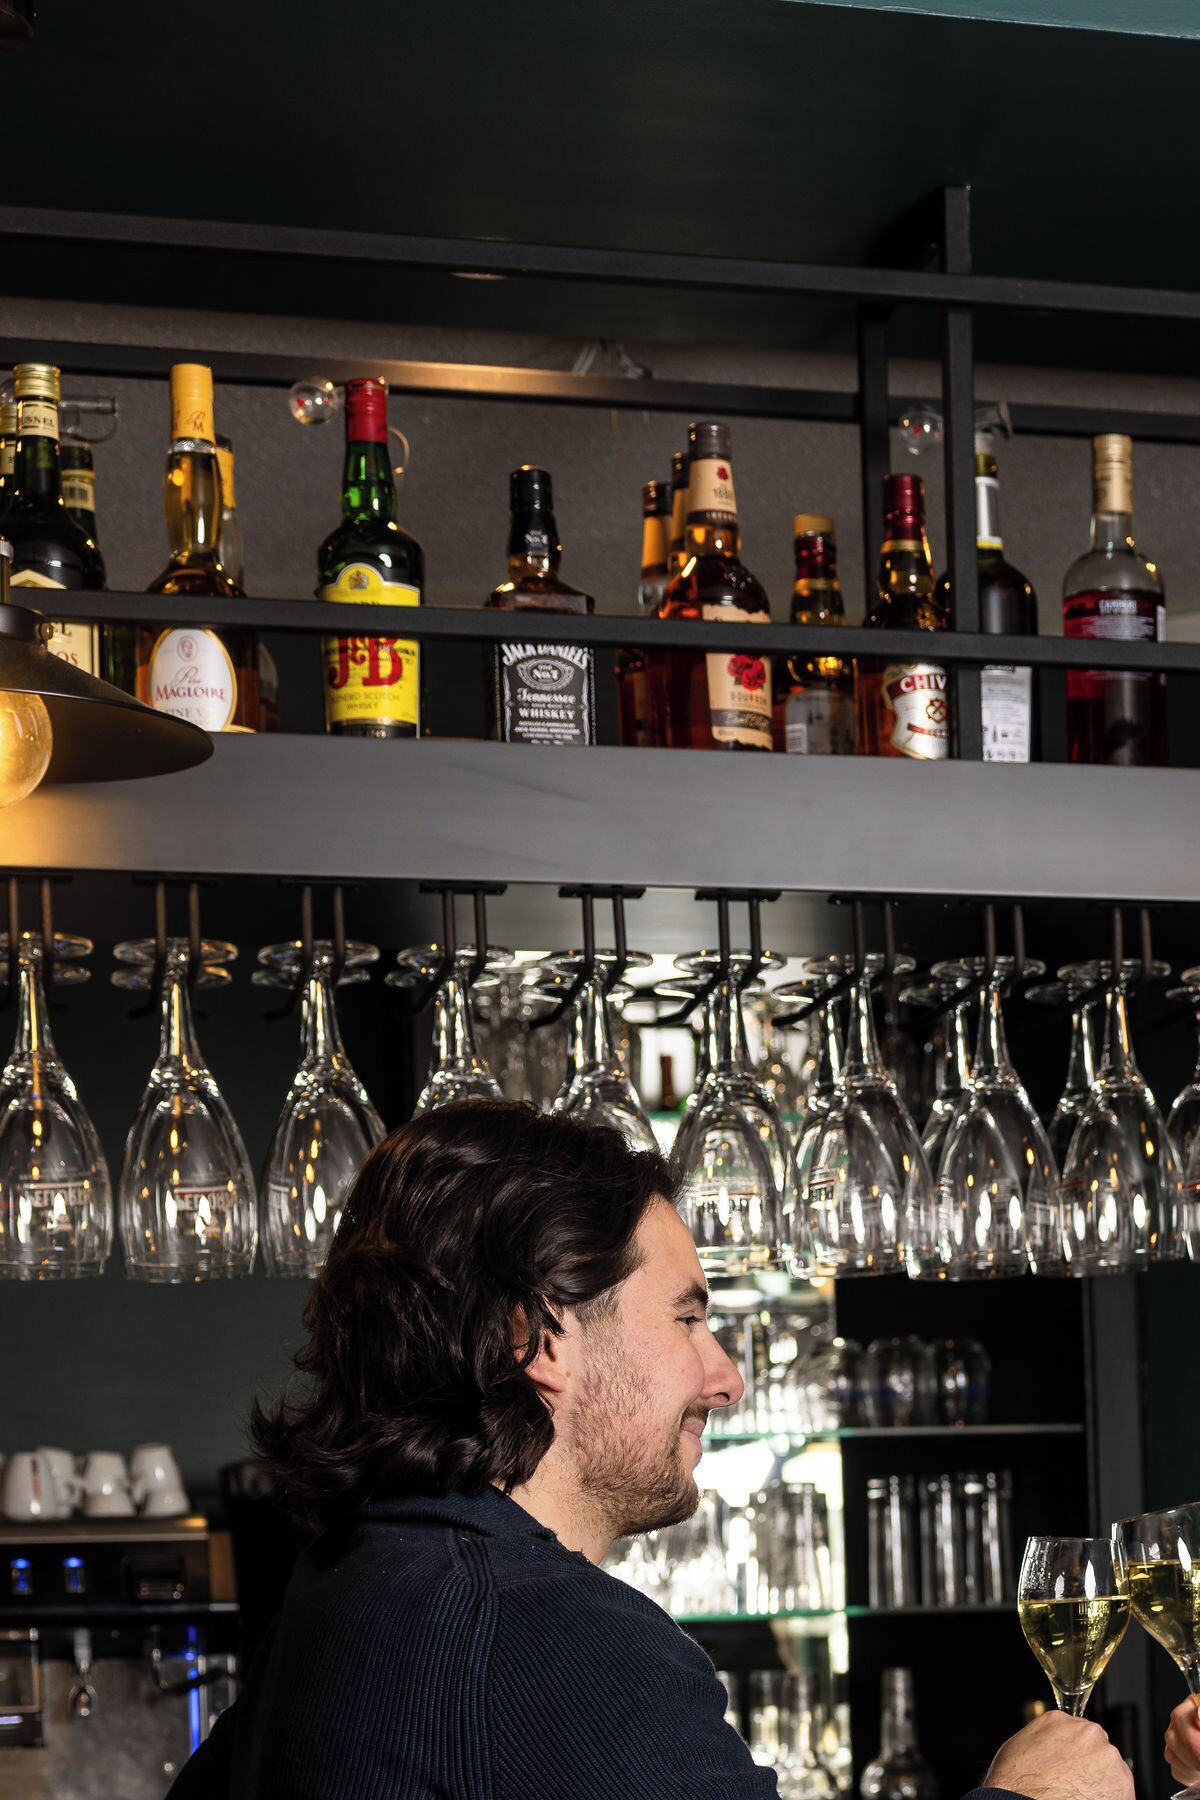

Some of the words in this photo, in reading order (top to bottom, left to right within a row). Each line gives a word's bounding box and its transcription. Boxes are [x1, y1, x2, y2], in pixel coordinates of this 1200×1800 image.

[155, 683, 227, 703] MAGLOIRE
[516, 687, 577, 705] Tennessee
[518, 707, 576, 720] WHISKEY
